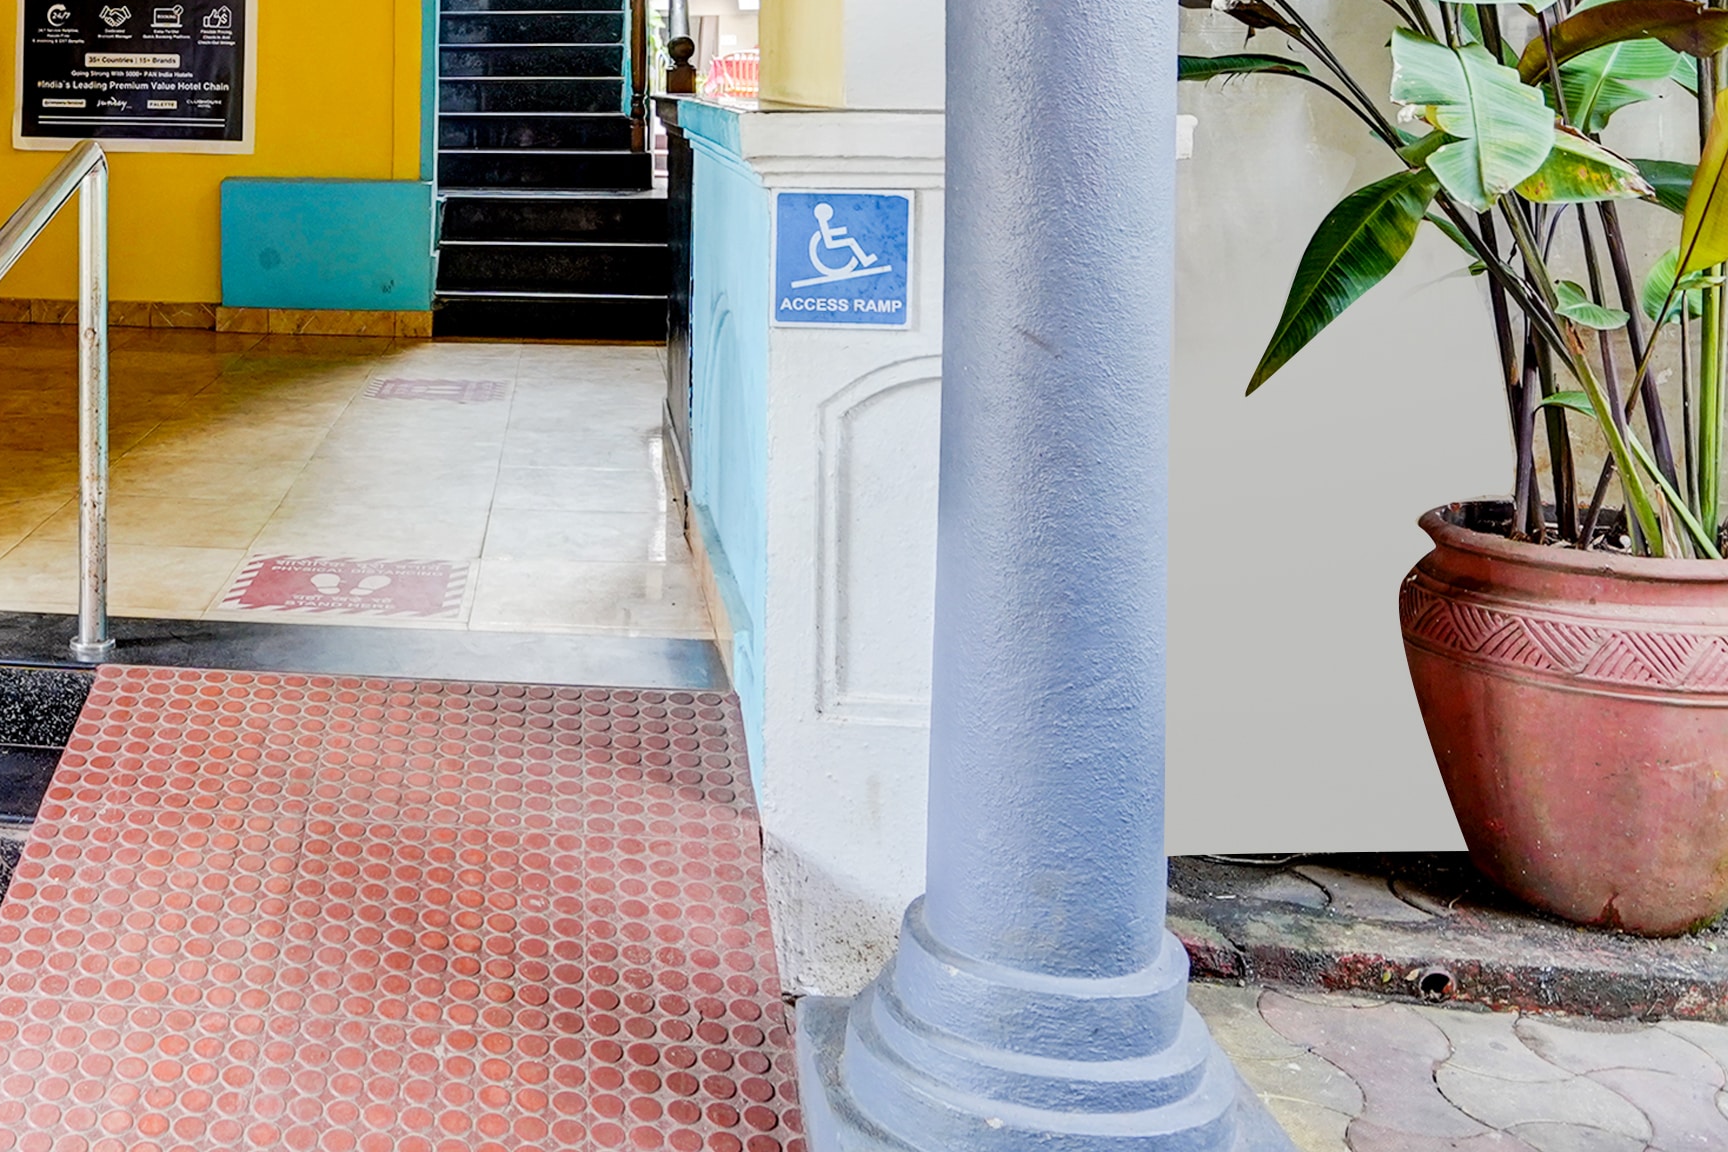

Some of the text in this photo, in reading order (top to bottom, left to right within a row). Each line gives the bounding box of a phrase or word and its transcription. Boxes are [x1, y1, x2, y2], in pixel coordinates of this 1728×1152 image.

[101, 56, 134, 64] Countries
[152, 57, 176, 65] Brands
[72, 80, 108, 91] Leading
[109, 81, 149, 90] Premium
[151, 81, 176, 91] Value
[177, 81, 202, 91] Hotel
[203, 81, 230, 91] Chain
[780, 297, 902, 313] ACCESS RAMP
[271, 565, 445, 577] PHYSICAL DISTANCING
[284, 599, 343, 607] STAND
